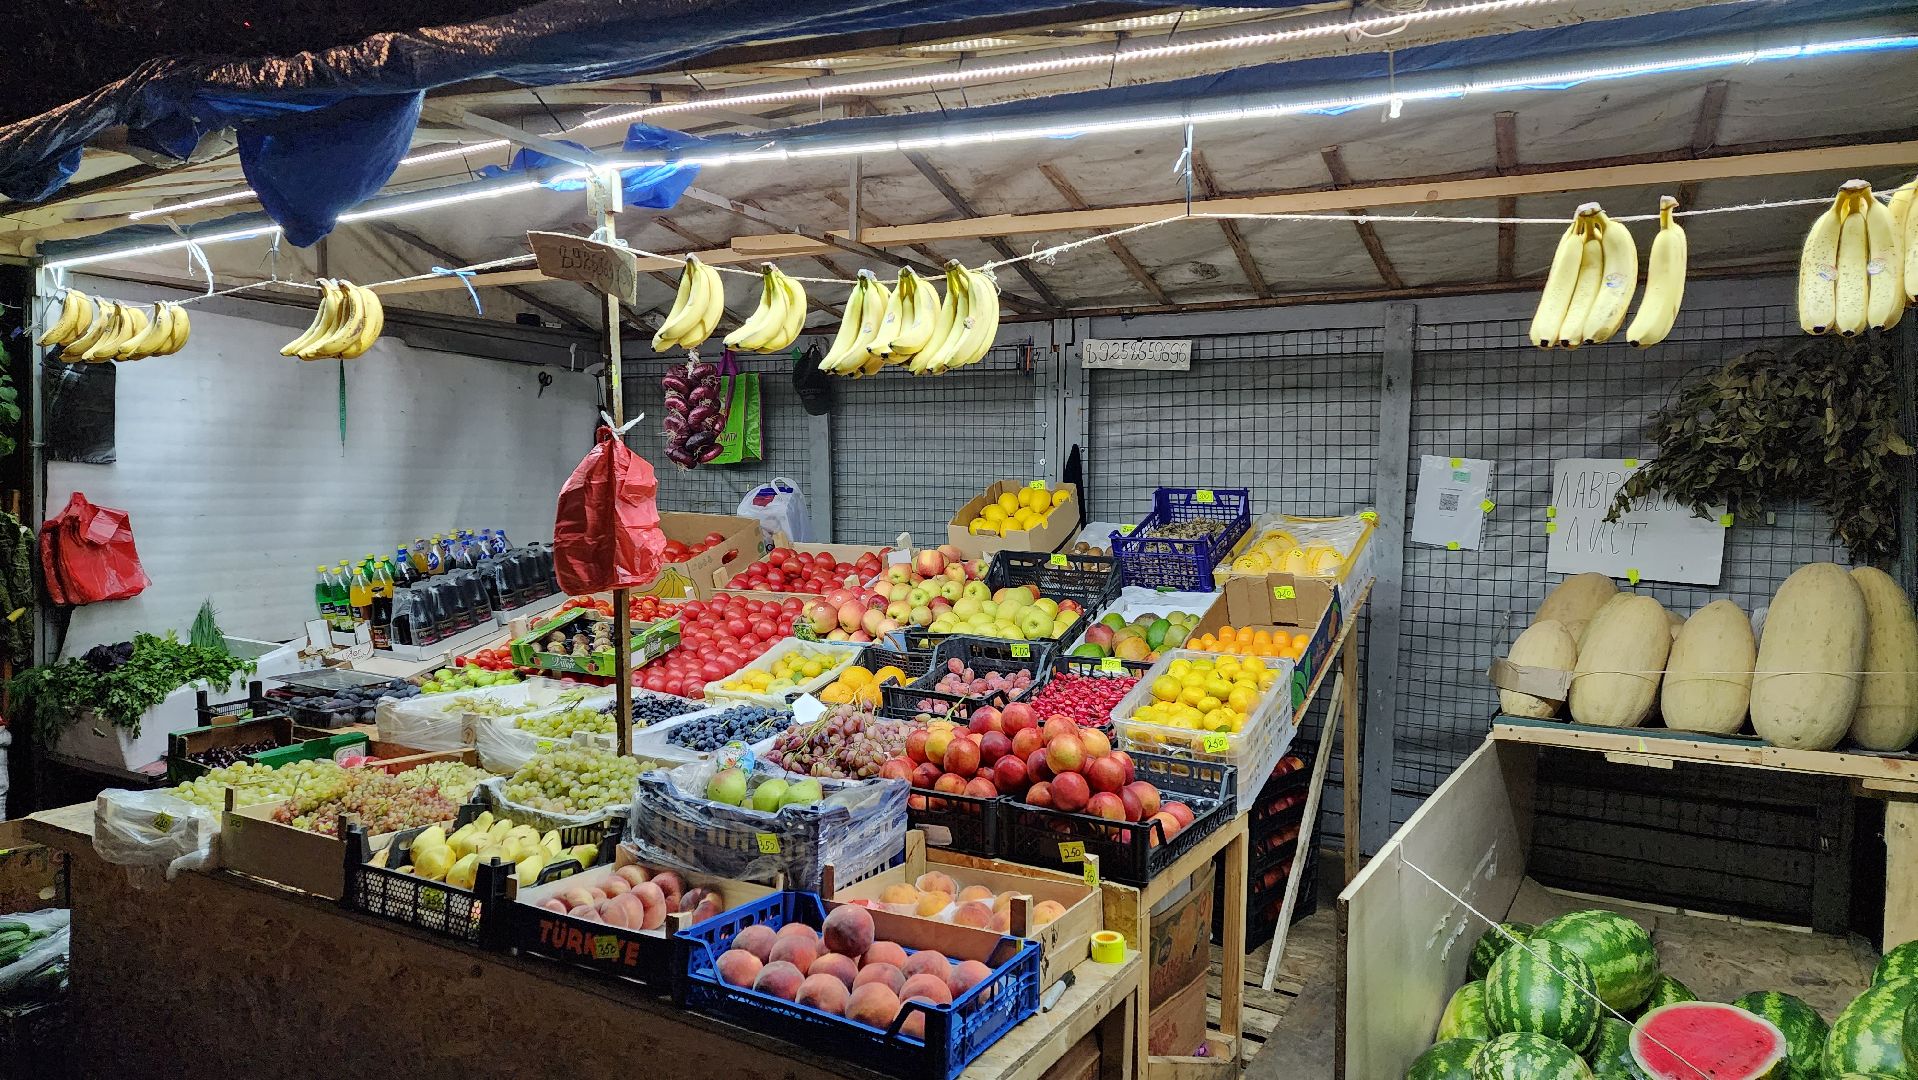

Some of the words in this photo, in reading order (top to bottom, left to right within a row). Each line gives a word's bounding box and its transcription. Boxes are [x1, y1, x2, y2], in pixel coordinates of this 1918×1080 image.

[1565, 516, 1648, 556] ЛИСТ
[1206, 739, 1223, 749] 250
[1064, 847, 1081, 859] 250
[540, 919, 640, 967] TÜRKE
